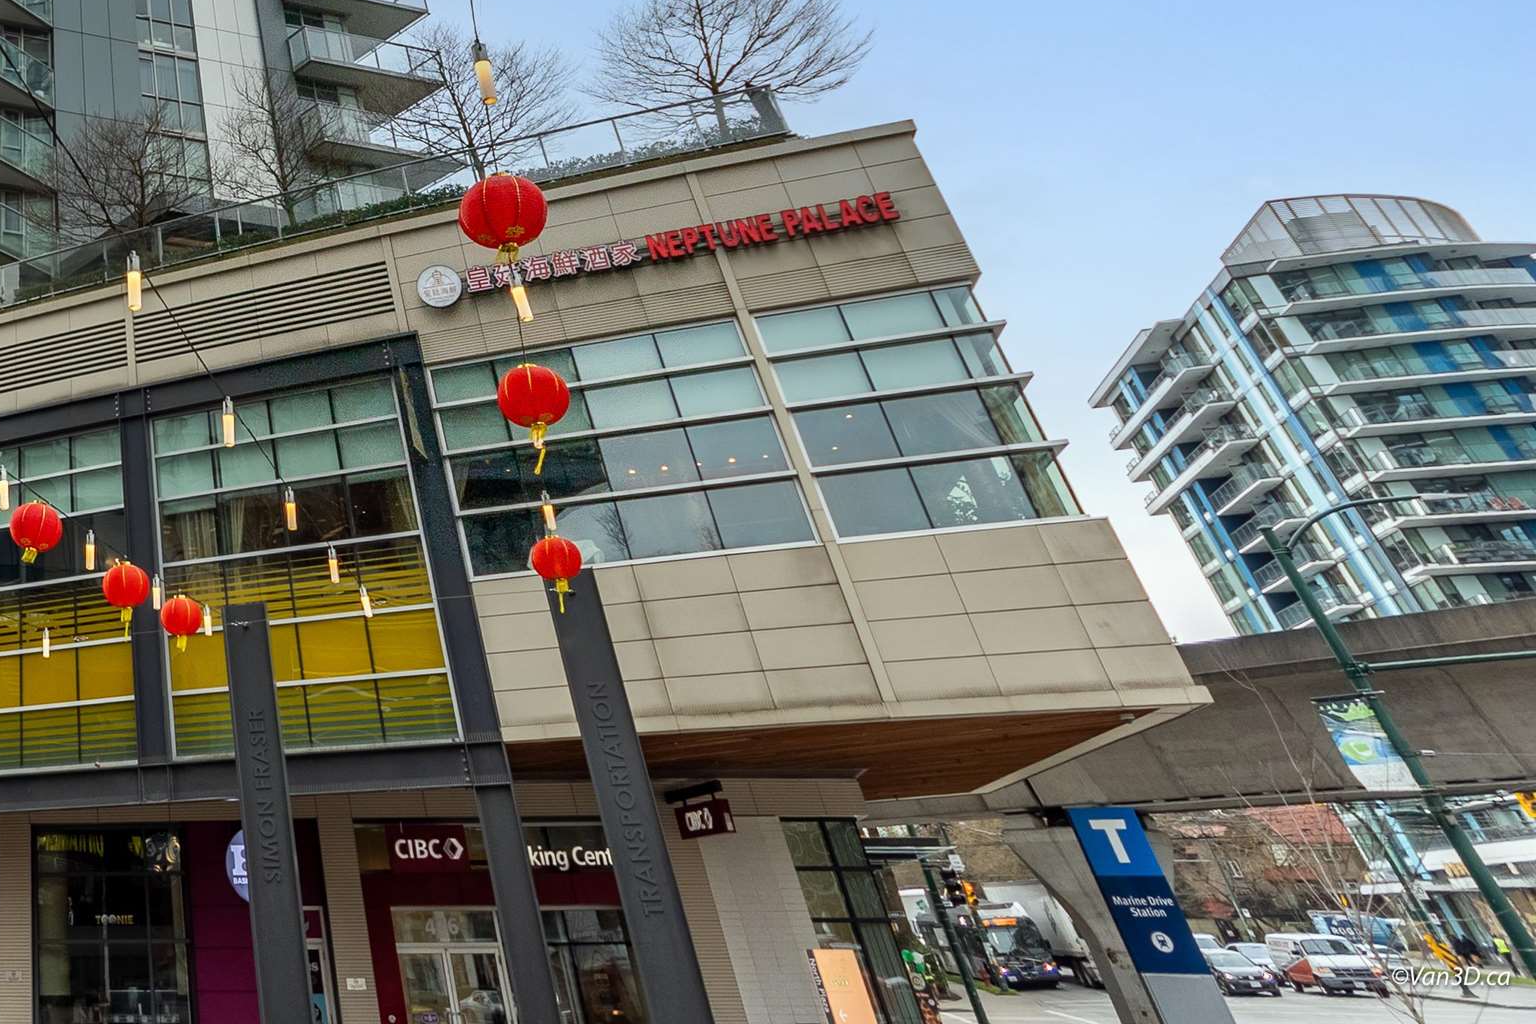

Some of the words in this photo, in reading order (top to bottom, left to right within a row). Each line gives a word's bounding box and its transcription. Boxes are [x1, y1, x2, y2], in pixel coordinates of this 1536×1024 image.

[644, 212, 780, 263] NEPTUNE
[780, 190, 901, 239] PALACE
[247, 708, 272, 792] FRASER
[584, 681, 665, 919] TRANSPORTATION
[257, 799, 281, 885] SIMON
[394, 838, 442, 860] CIBC
[1088, 818, 1131, 864] T
[1111, 895, 1148, 906] Marine
[1149, 895, 1175, 907] Drive
[1131, 906, 1168, 918] Station
